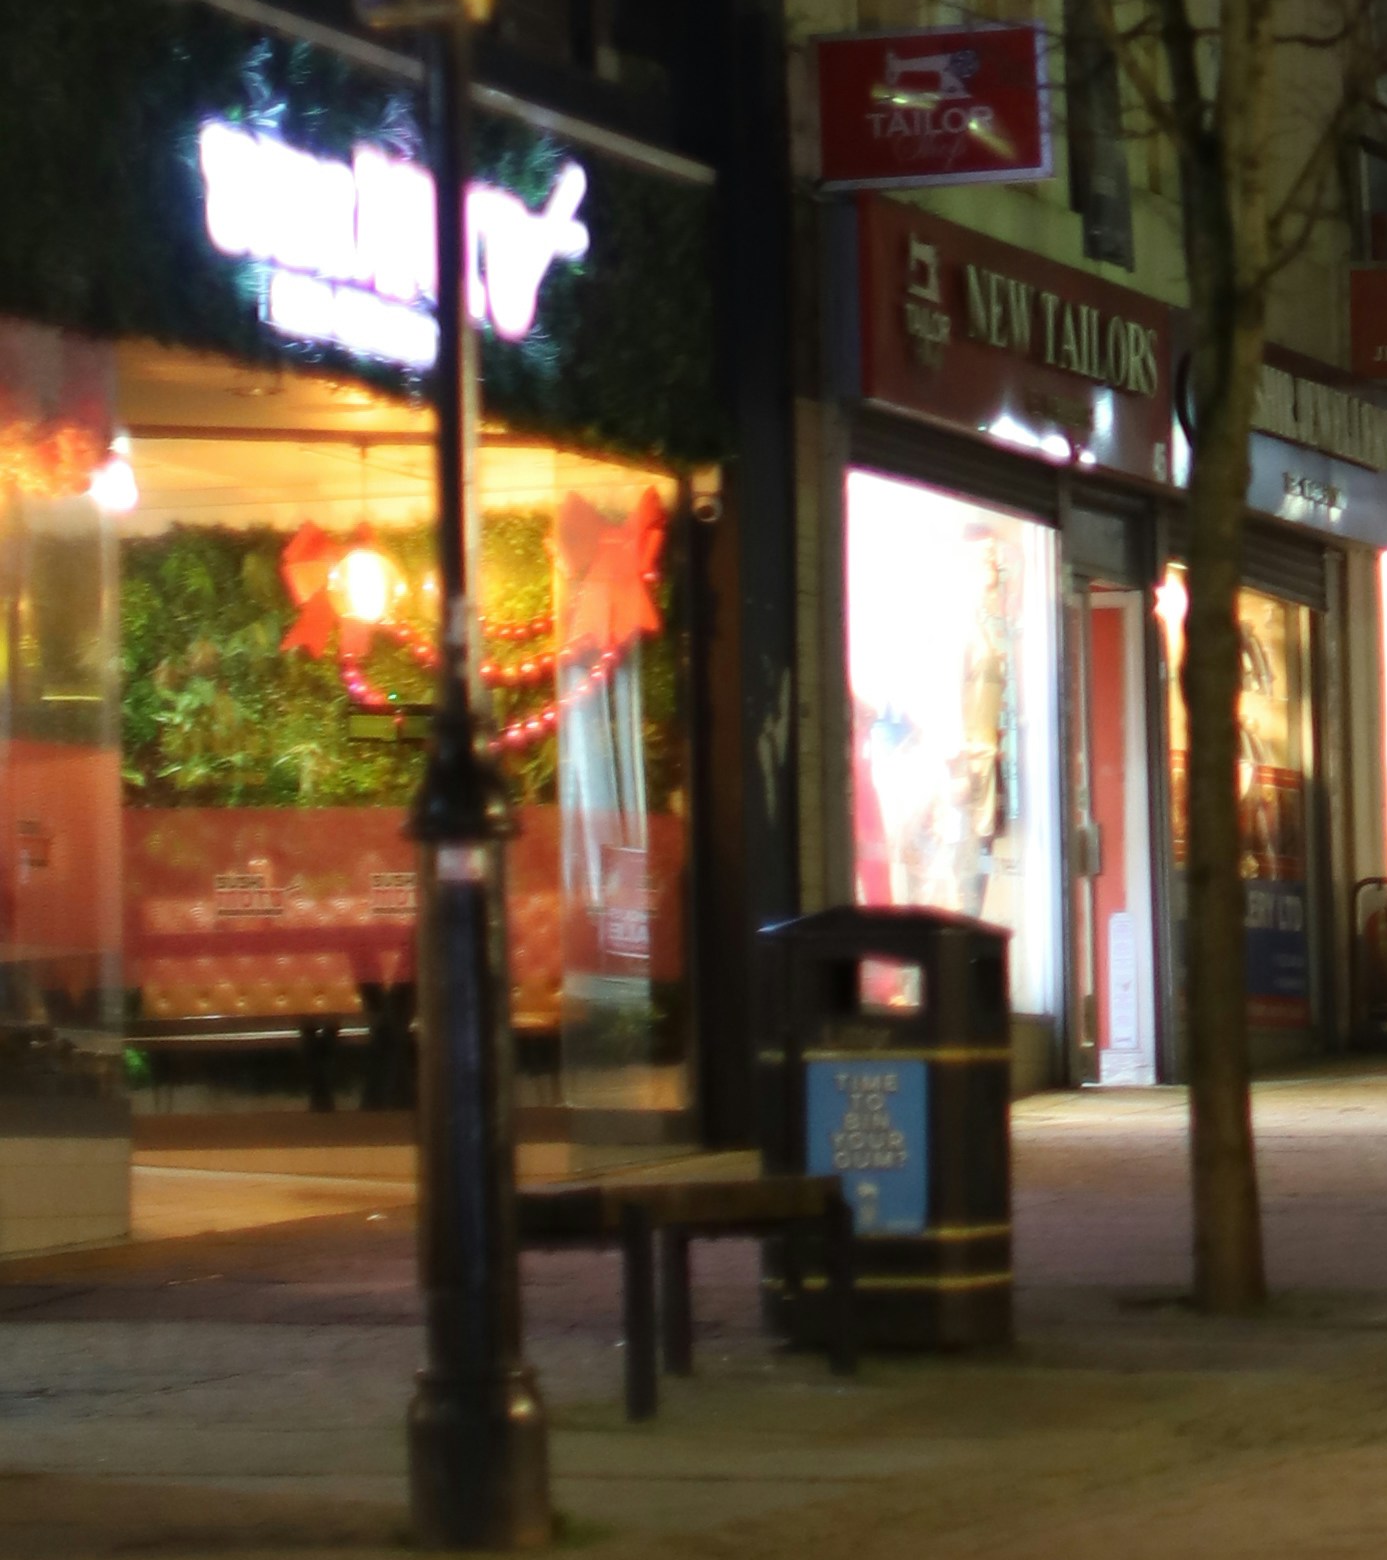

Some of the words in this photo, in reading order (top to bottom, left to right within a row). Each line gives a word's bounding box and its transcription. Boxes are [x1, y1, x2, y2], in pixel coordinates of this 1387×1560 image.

[866, 106, 993, 139] TAILOR
[966, 263, 1033, 353] NEW
[1040, 290, 1159, 399] TAILORS
[834, 1073, 898, 1092] TIME
[850, 1092, 884, 1111] TO
[843, 1111, 889, 1130] BIN
[831, 1130, 905, 1150] YOUR
